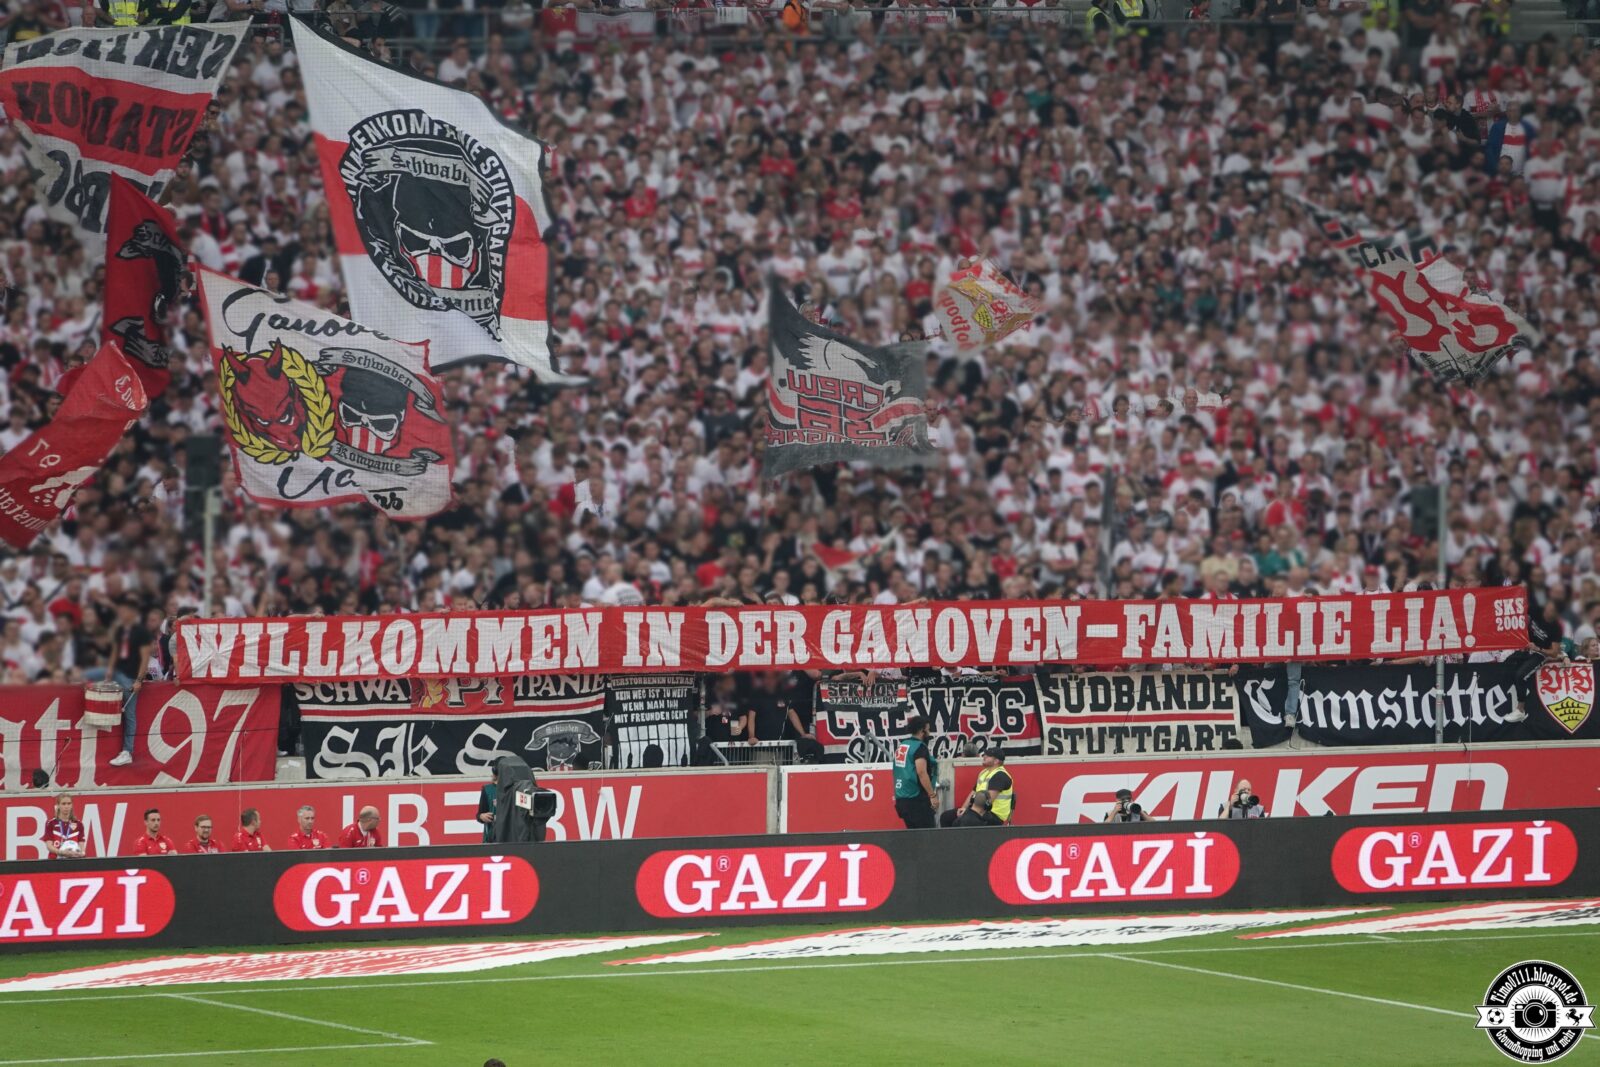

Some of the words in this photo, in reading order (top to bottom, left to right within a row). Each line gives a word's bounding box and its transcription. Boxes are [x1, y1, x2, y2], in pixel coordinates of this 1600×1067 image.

[341, 350, 413, 388] Schwaben
[335, 442, 402, 474] Kompanie
[1494, 597, 1525, 617] SKS
[181, 609, 602, 678] WILLKOMMEN
[622, 609, 685, 667] IN
[705, 610, 809, 666] DER
[820, 600, 1351, 665] GANOVEN-FAMILIE
[1370, 592, 1477, 654] LIA!
[1496, 616, 1526, 632] 2006
[1043, 673, 1235, 714] SÜDBANDE
[614, 713, 629, 724] MIT
[630, 711, 670, 723] FREUNDEN
[148, 688, 260, 786] 97
[1047, 724, 1239, 755] STUTTGART
[844, 773, 875, 802] 36
